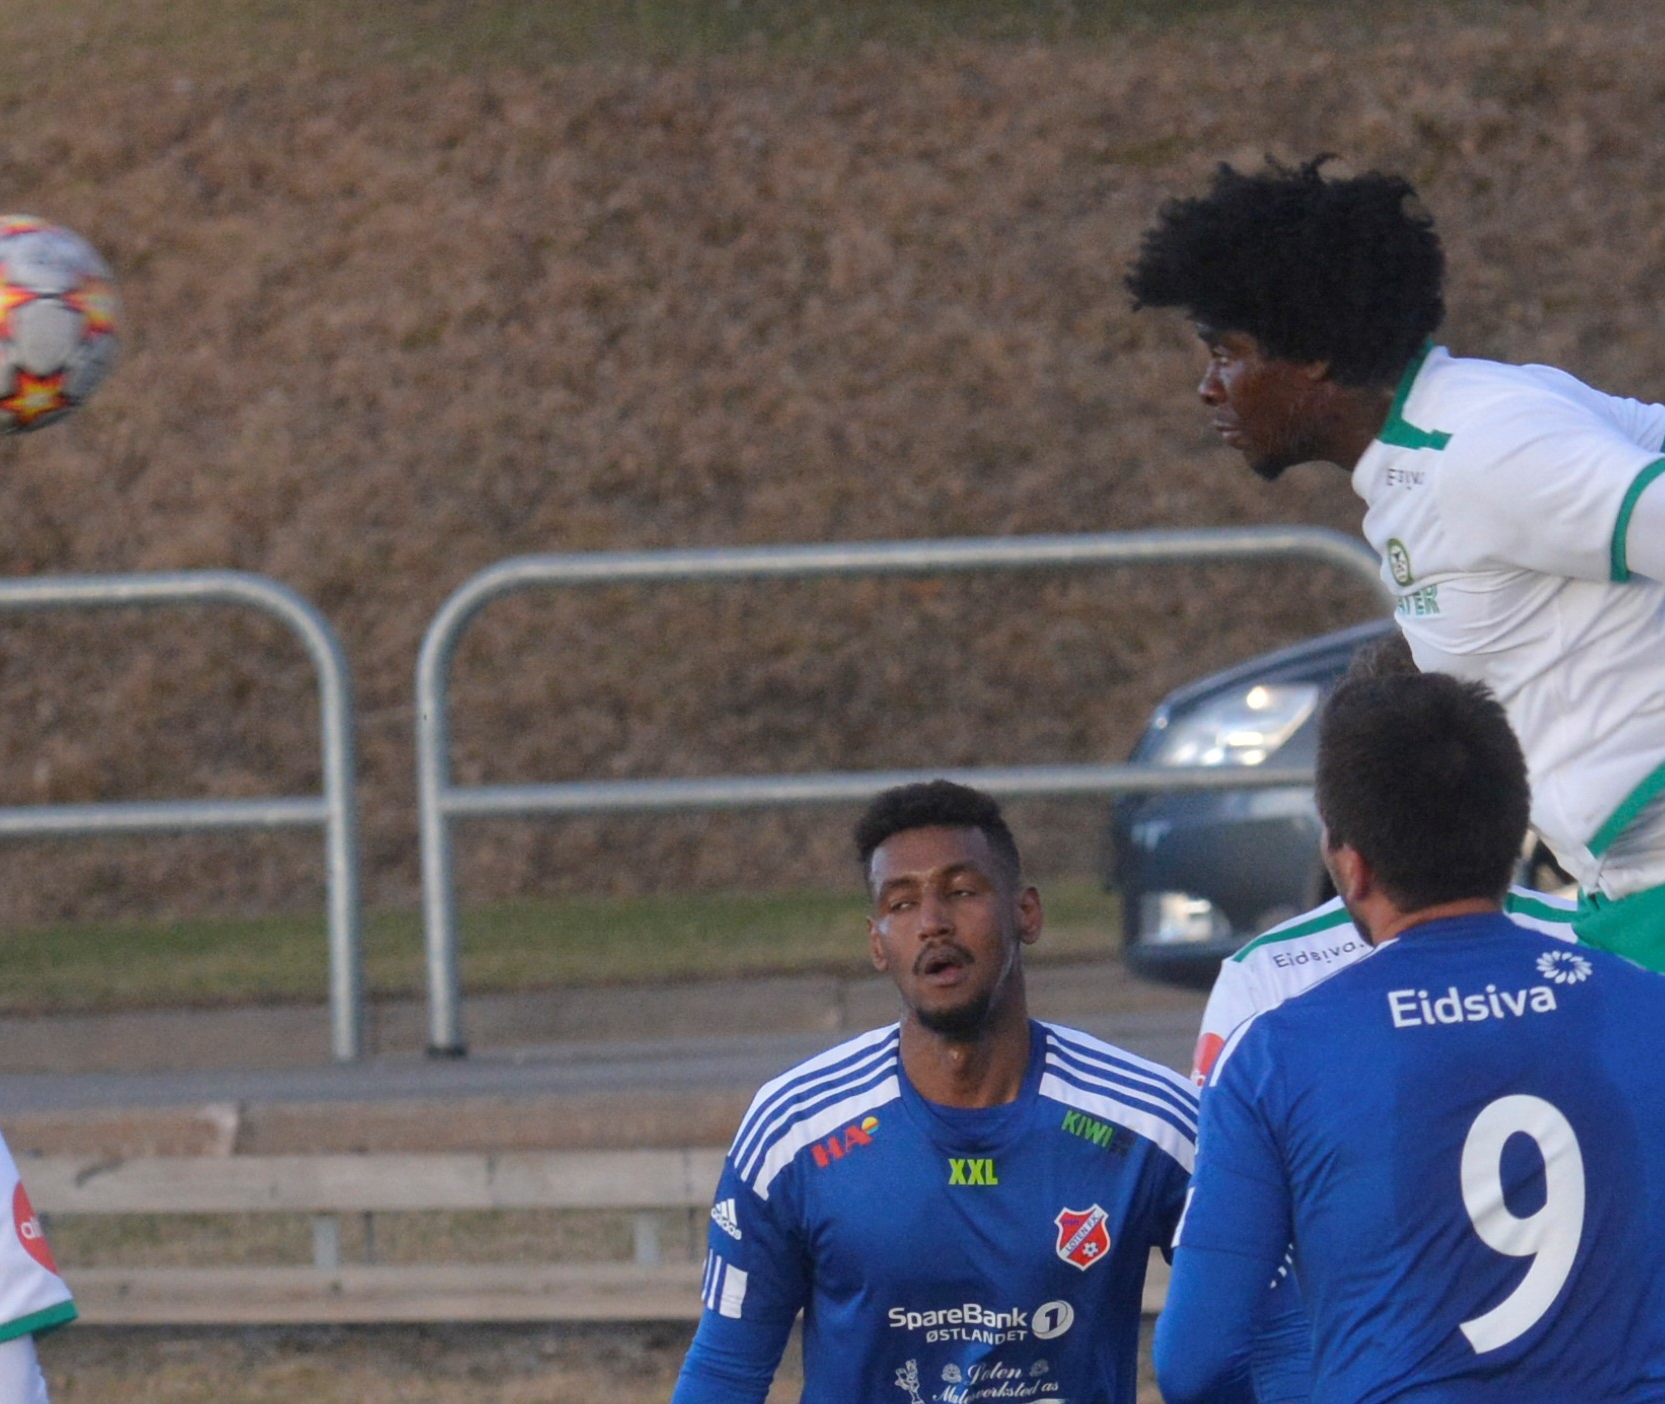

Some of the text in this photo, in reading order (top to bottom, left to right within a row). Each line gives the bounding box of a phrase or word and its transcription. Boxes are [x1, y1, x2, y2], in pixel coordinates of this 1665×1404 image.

[1387, 984, 1557, 1028] Eidsiva
[1061, 1109, 1113, 1149] KIWI
[949, 1158, 998, 1185] XXL
[1458, 1094, 1585, 1355] 9
[888, 1303, 1028, 1330] SpareBank
[926, 1328, 1028, 1346] ØSTLANDET
[1041, 1381, 1059, 1392] as
